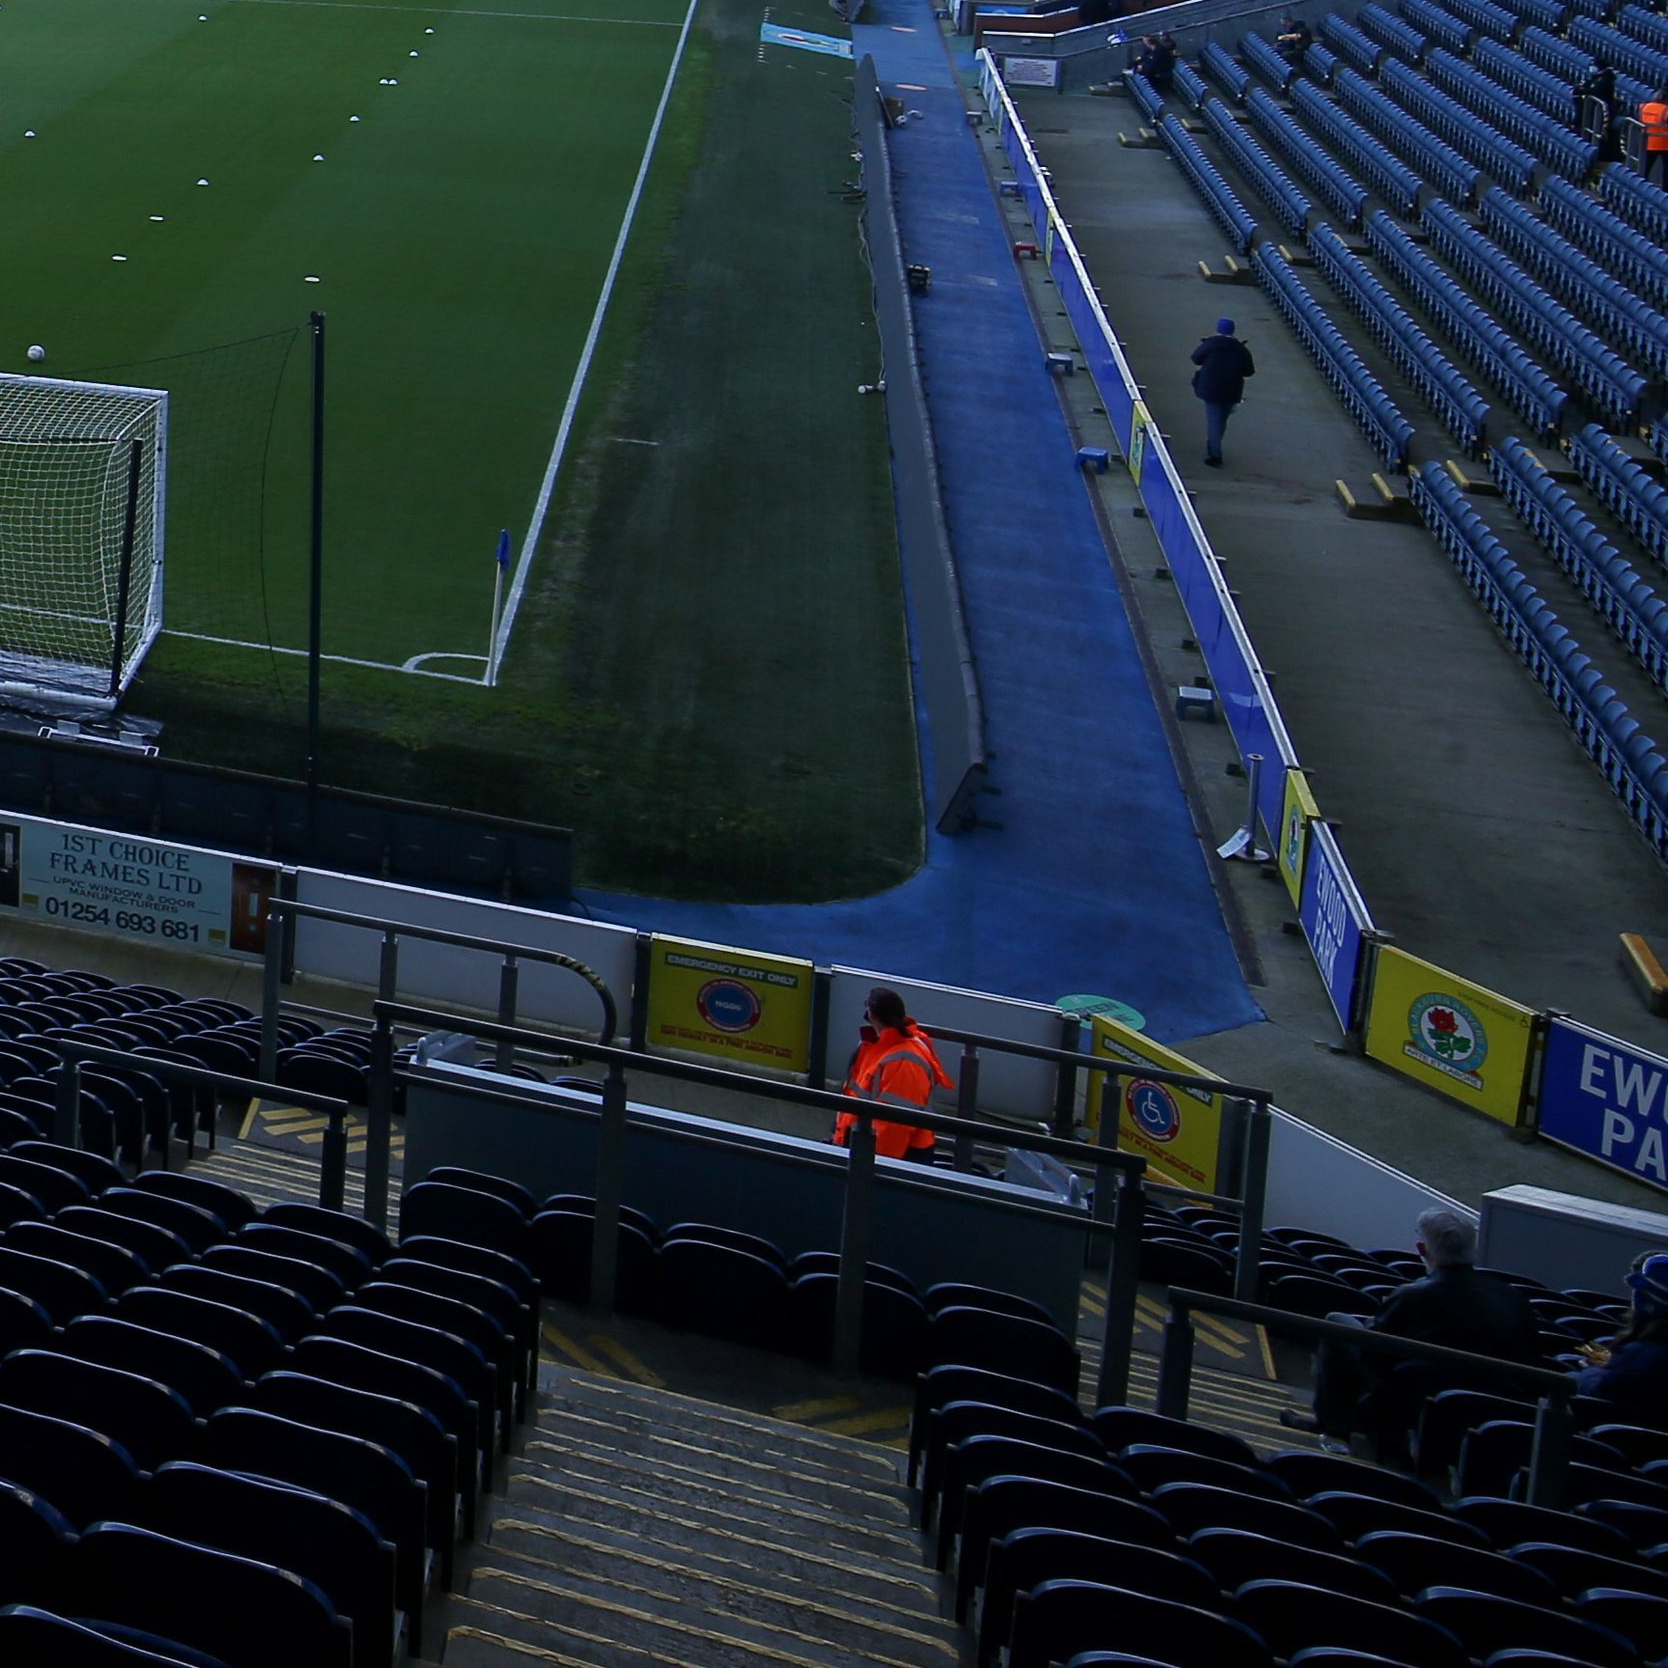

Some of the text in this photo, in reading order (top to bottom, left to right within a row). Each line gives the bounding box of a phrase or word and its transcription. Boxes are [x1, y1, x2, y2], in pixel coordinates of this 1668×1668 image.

[62, 834, 190, 872] 1ST CHOICE
[50, 852, 203, 895] FRAMES LTD
[53, 876, 196, 909] UPVC WINDOW & DOOR
[46, 896, 200, 942] 01254 693 681
[69, 887, 179, 914] MANUFACTURERS
[1316, 854, 1347, 948] EWOOD
[1312, 906, 1338, 989] PARK
[667, 953, 797, 987] EMERGENCY EXIT ONLY
[1406, 1047, 1479, 1085] ARTE ET LABORE
[1580, 1043, 1668, 1127] EW
